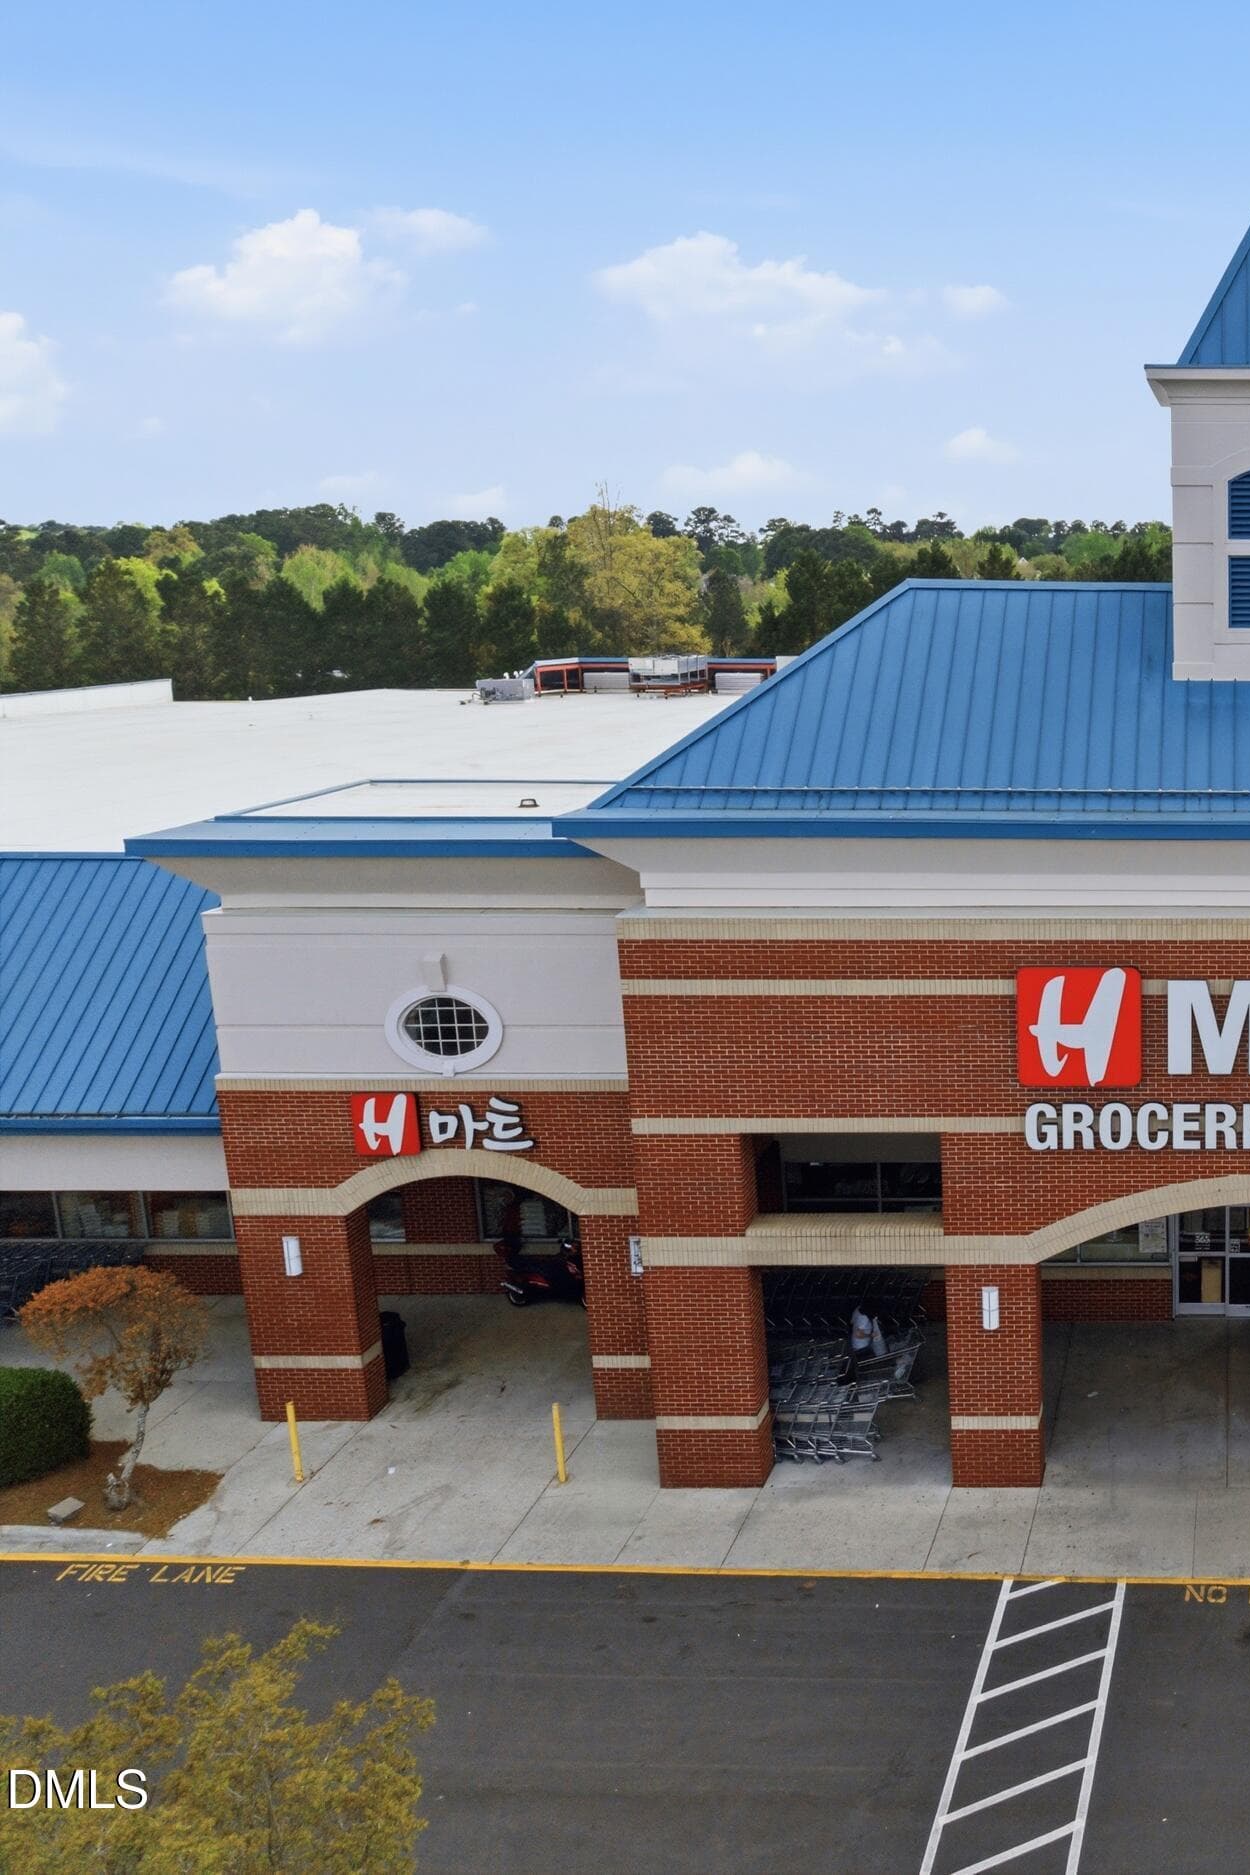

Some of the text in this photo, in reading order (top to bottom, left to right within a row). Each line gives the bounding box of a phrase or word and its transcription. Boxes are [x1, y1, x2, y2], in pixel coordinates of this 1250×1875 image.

[1029, 967, 1127, 1087] H
[358, 1093, 534, 1155] H 마트
[56, 1563, 245, 1585] FIRE LANE
[1185, 1585, 1227, 1604] NO
